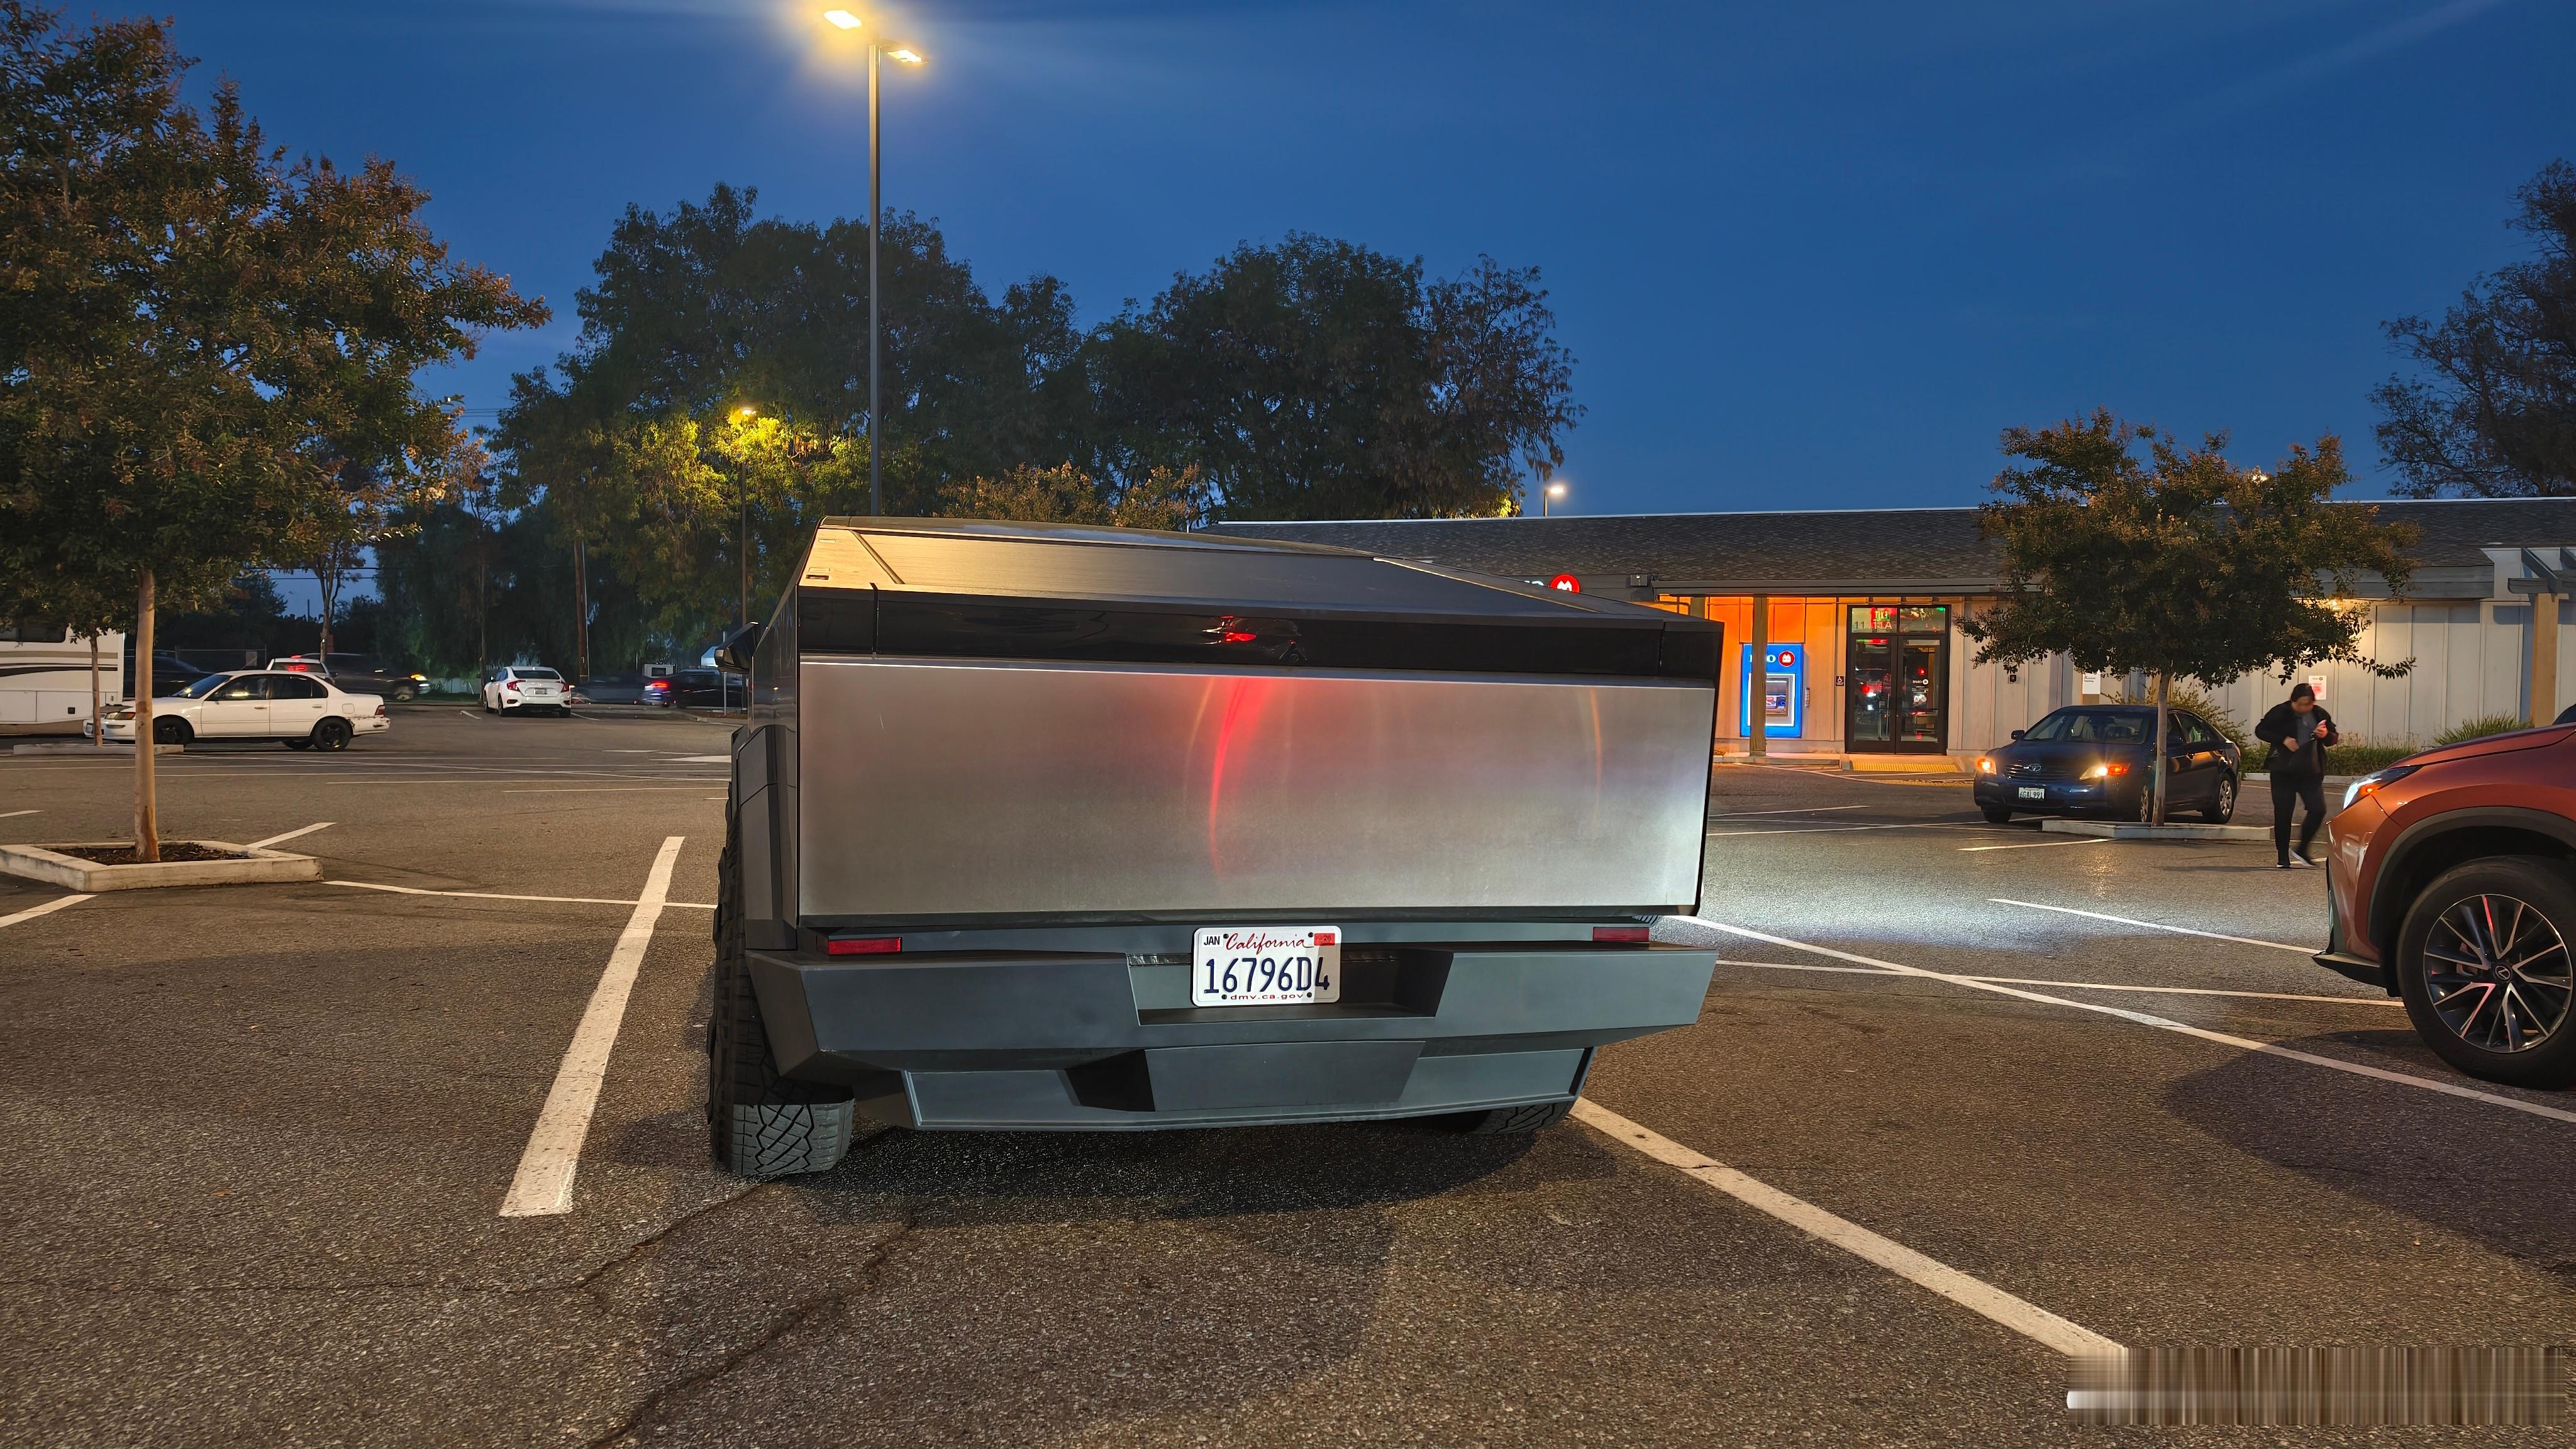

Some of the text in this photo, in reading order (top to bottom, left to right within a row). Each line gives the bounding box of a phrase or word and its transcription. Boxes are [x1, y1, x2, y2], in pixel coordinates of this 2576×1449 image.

[1204, 936, 1220, 945] JAN
[1226, 933, 1314, 955] California
[1204, 957, 1330, 994] 16796D4
